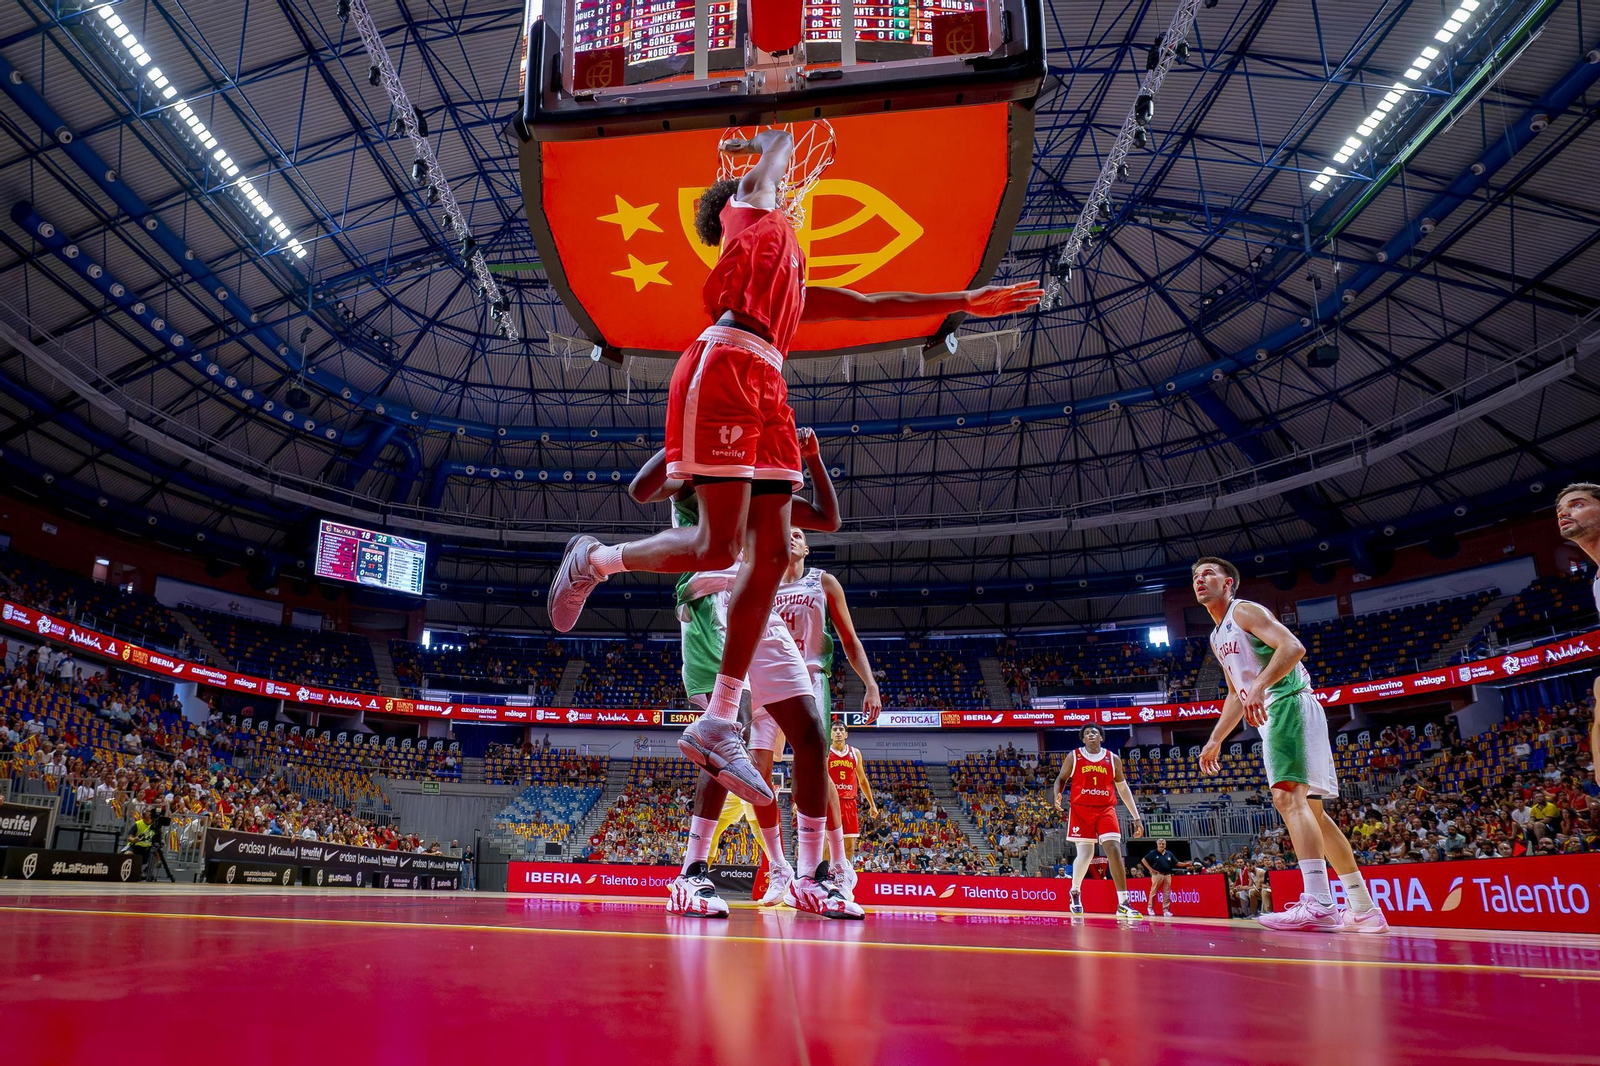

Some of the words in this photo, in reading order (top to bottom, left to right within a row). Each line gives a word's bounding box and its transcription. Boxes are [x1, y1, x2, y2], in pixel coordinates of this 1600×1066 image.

[651, 2, 675, 13] MILLER
[666, 21, 695, 31] GRAHAM
[365, 552, 382, 562] 8:46
[774, 594, 816, 609] RTUGAL
[1546, 641, 1593, 662] Andalucía
[150, 656, 174, 668] IBERIA
[192, 668, 227, 680] azulmarino
[1353, 681, 1403, 694] azulmarino
[1179, 705, 1221, 718] Andalucía
[830, 760, 853, 769] ESPAÑA
[1082, 765, 1108, 775] ESPAÑA
[840, 771, 846, 780] 5
[1093, 776, 1097, 785] 1
[238, 842, 266, 854] endesa
[52, 862, 108, 875] #LaFamilia
[721, 869, 752, 878] endesa
[526, 872, 582, 884] IBERIA
[601, 875, 638, 886] Talento
[874, 883, 936, 896] IBERIA
[962, 886, 1008, 899] Talento
[1011, 890, 1018, 899] a
[1021, 887, 1056, 901] bordo
[1126, 890, 1147, 902] BERIA
[1183, 889, 1200, 903] bordo
[1331, 876, 1433, 912] BRIA
[1472, 875, 1590, 913] Talento
